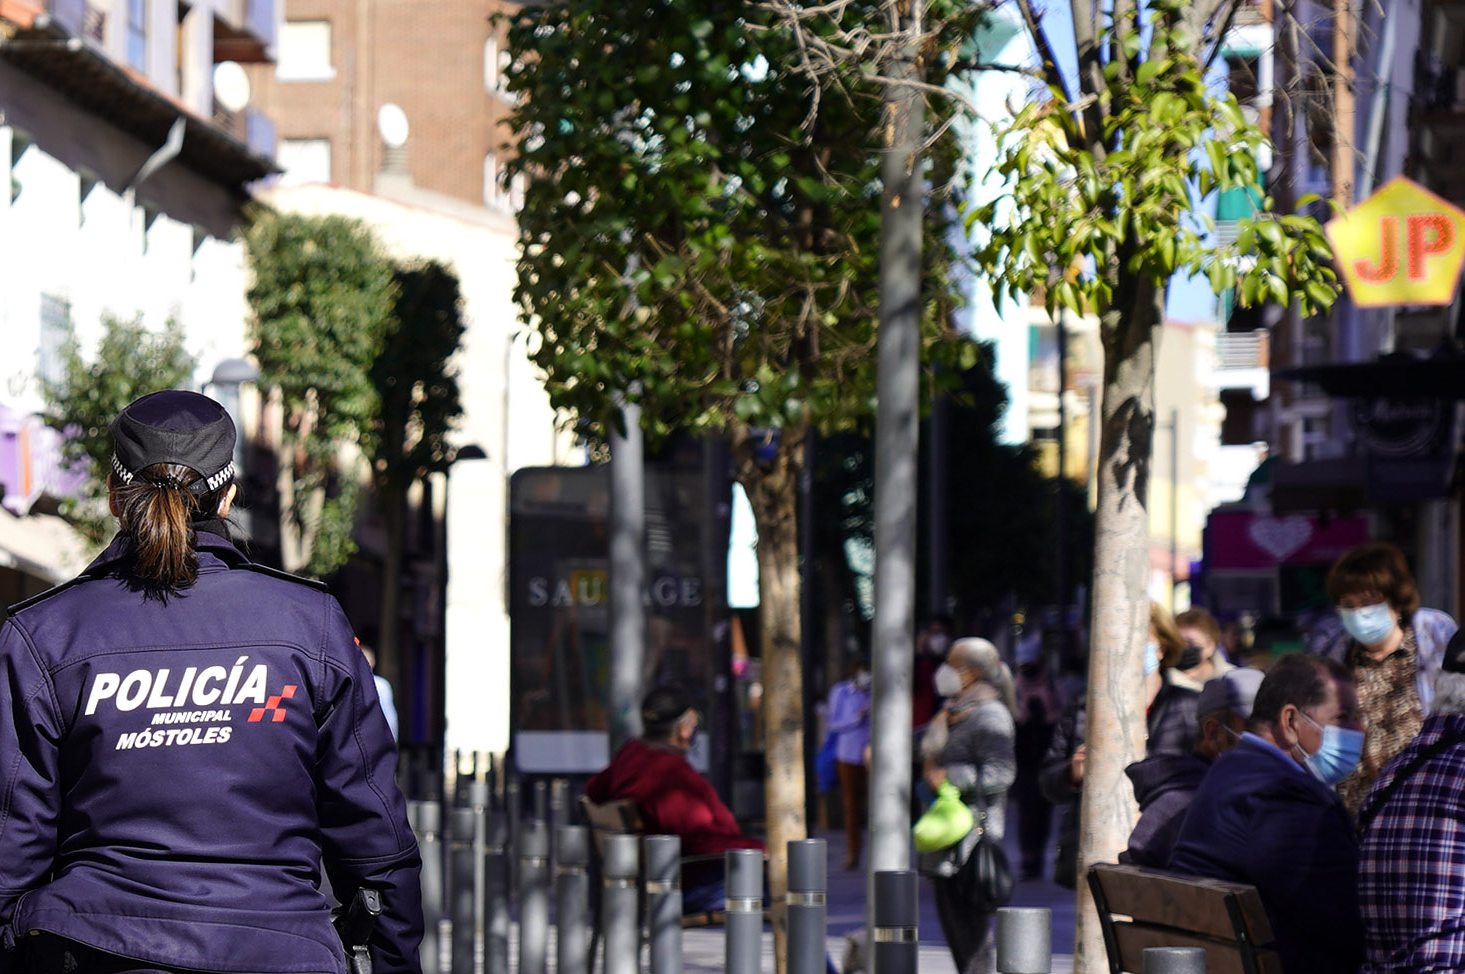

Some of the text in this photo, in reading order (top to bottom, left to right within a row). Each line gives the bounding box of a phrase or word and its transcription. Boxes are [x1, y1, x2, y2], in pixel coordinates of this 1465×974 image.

[1354, 213, 1457, 283] JP
[85, 656, 267, 715] POLICÍA
[115, 726, 232, 750] MÓSTOLES
[151, 710, 232, 725] MUNICIPAL
